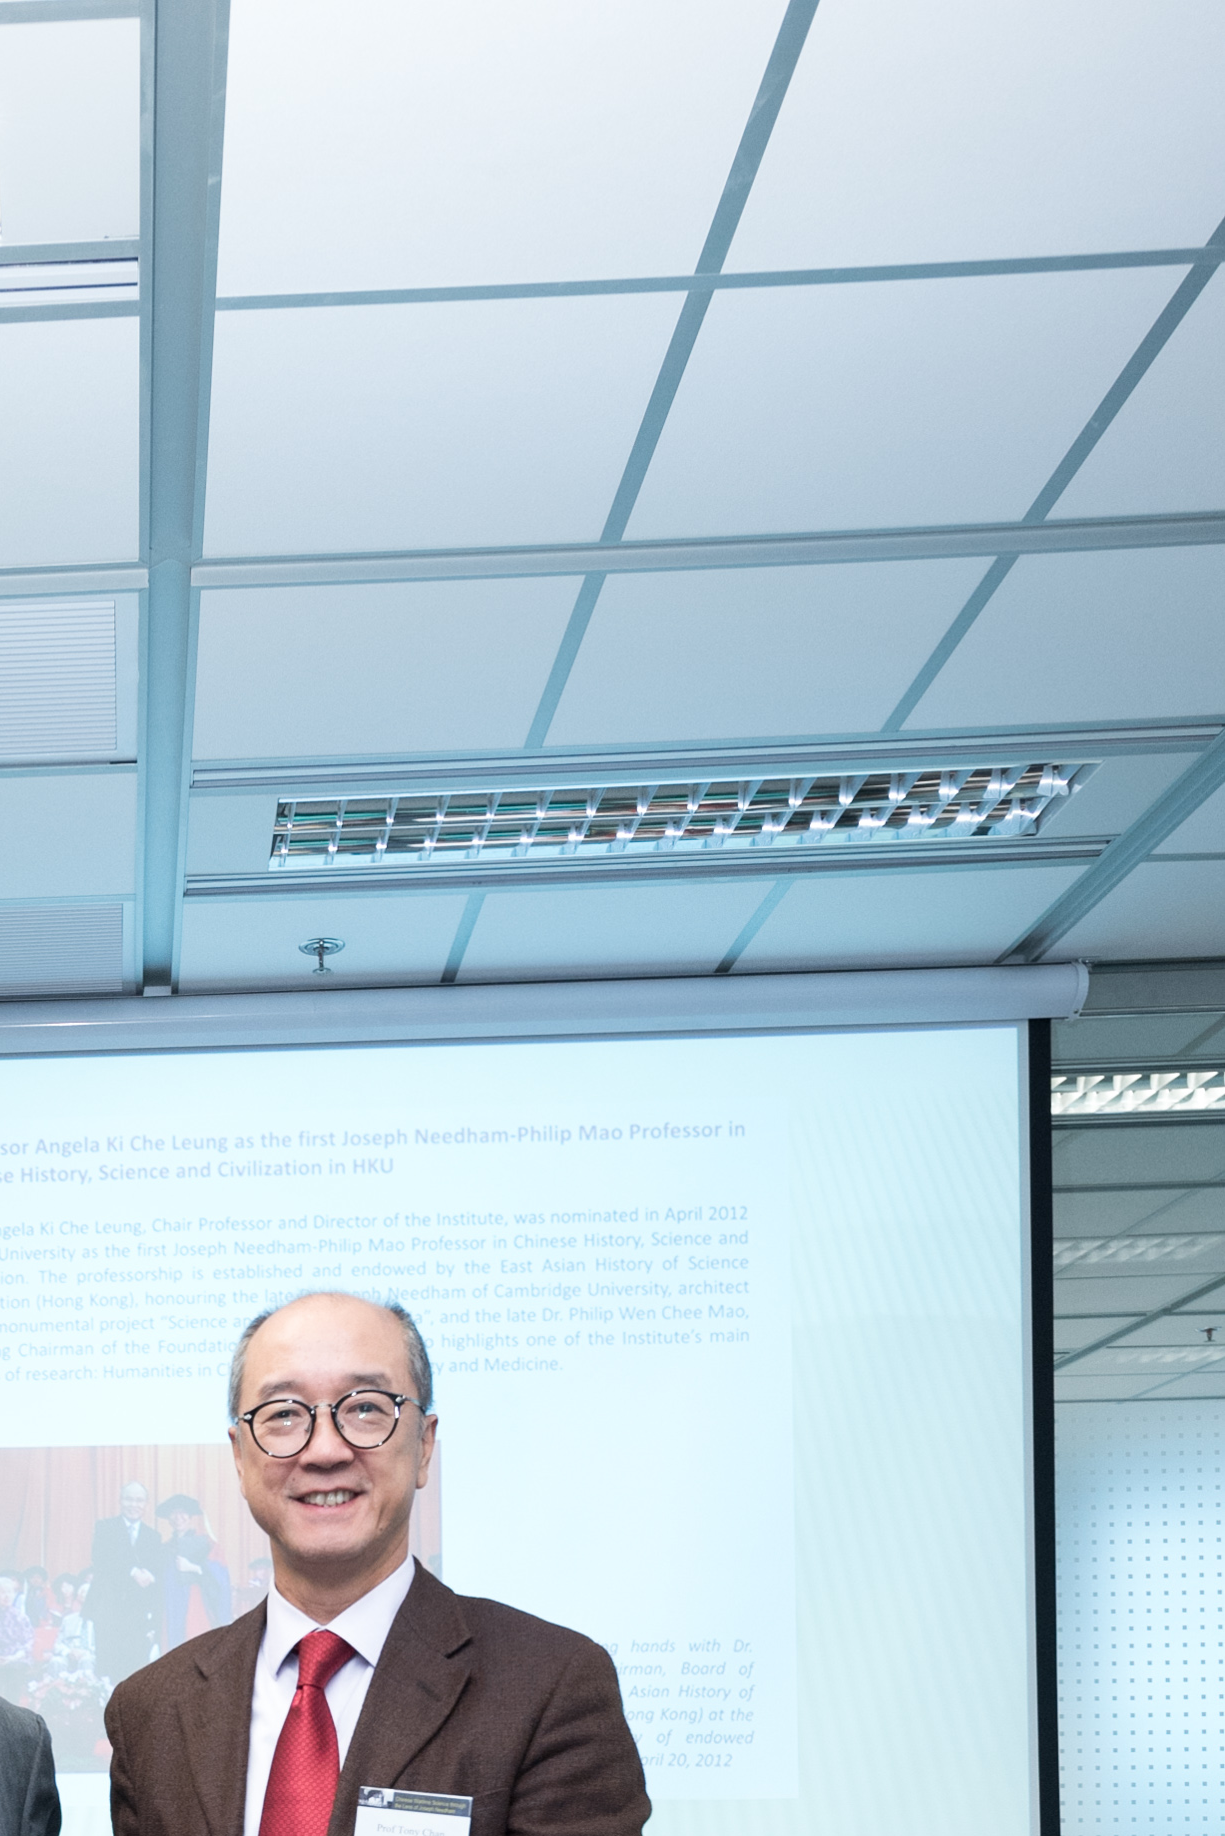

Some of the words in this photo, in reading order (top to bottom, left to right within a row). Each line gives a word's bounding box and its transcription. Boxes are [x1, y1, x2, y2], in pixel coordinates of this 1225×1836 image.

[34, 1136, 101, 1158] Angela
[106, 1135, 124, 1153] Ki
[129, 1134, 166, 1152] Che
[171, 1134, 229, 1154] Leung
[233, 1135, 255, 1150] as
[259, 1130, 293, 1149] the
[297, 1130, 337, 1148] first
[341, 1128, 409, 1149] Joseph
[414, 1125, 573, 1145] Needham-Philip
[578, 1124, 624, 1141] Mao
[628, 1121, 723, 1140] Professor
[727, 1119, 746, 1138] in
[20, 1166, 93, 1184] History,
[98, 1163, 170, 1181] Science
[175, 1161, 212, 1179] and
[216, 1159, 323, 1178] Civilization
[328, 1158, 347, 1175] in
[352, 1156, 395, 1175] HKU
[39, 1220, 55, 1236] Ki
[58, 1220, 90, 1236] Che
[94, 1220, 147, 1237] Leung,
[151, 1217, 193, 1233] Chair
[198, 1216, 273, 1232] Professor
[277, 1214, 308, 1231] and
[312, 1213, 379, 1230] Director
[382, 1212, 401, 1228] of
[403, 1211, 432, 1228] the
[436, 1211, 509, 1227] Institute,
[512, 1211, 547, 1225] was
[549, 1206, 640, 1224] nominated
[644, 1206, 660, 1222] in
[663, 1205, 704, 1225] April
[707, 1204, 749, 1222] 2012
[81, 1246, 99, 1259] as
[104, 1243, 132, 1259] the
[136, 1241, 167, 1258] first
[172, 1241, 228, 1257] Joseph
[233, 1238, 363, 1255] Needham-Philip
[367, 1236, 406, 1253] Mao
[410, 1235, 487, 1252] Professor
[492, 1234, 508, 1249] in
[512, 1233, 578, 1250] Chinese
[583, 1232, 645, 1249] History,
[650, 1230, 713, 1247] Science
[717, 1229, 750, 1245] and
[37, 1268, 68, 1284] The
[76, 1266, 184, 1285] professorship
[191, 1265, 205, 1281] is
[212, 1263, 304, 1280] established
[311, 1262, 343, 1278] and
[350, 1261, 427, 1277] endowed
[435, 1259, 456, 1279] by
[463, 1259, 492, 1275] the
[499, 1258, 533, 1274] East
[541, 1257, 587, 1273] Asian
[594, 1256, 654, 1274] History
[661, 1253, 680, 1272] of
[687, 1254, 750, 1271] Science
[35, 1294, 85, 1312] (Hong
[88, 1292, 139, 1310] Kong),
[144, 1291, 227, 1308] honouring
[231, 1288, 260, 1304] the
[387, 1284, 467, 1302] Needham
[471, 1282, 490, 1300] of
[493, 1282, 582, 1301] Cambridge
[587, 1281, 673, 1298] University,
[677, 1279, 750, 1295] architect
[98, 1316, 156, 1334] project
[159, 1314, 228, 1330] “Science
[232, 1317, 252, 1329] an
[439, 1308, 471, 1325] and
[474, 1307, 503, 1324] the
[506, 1307, 537, 1323] late
[541, 1306, 564, 1323] Dr.
[568, 1305, 615, 1323] Philip
[617, 1305, 657, 1321] Wen
[660, 1304, 704, 1321] Chee
[707, 1304, 750, 1320] Mao,
[17, 1342, 95, 1358] Chairman
[100, 1339, 118, 1356] of
[123, 1339, 151, 1355] the
[157, 1338, 237, 1354] Foundatio
[440, 1332, 520, 1352] highlights
[525, 1334, 558, 1348] one
[563, 1329, 582, 1347] of
[586, 1330, 616, 1346] the
[621, 1328, 703, 1345] Institute’s
[709, 1327, 751, 1343] main
[4, 1365, 23, 1382] of
[25, 1365, 98, 1381] research:
[102, 1364, 194, 1379] Humanities
[197, 1363, 213, 1377] in
[447, 1356, 480, 1373] and
[483, 1356, 564, 1372] Medicine.
[629, 1639, 677, 1653] hands
[687, 1637, 722, 1653] with
[732, 1637, 753, 1653] Dr.
[617, 1662, 667, 1678] irman,
[680, 1660, 727, 1676] Board
[737, 1660, 756, 1679] of
[627, 1684, 671, 1699] Asian
[677, 1684, 733, 1702] History
[737, 1683, 757, 1702] of
[626, 1709, 655, 1724] ong
[659, 1706, 704, 1725] Kong)
[707, 1708, 725, 1722] at
[729, 1706, 755, 1722] the
[655, 1727, 674, 1747] of
[684, 1728, 756, 1745] endowed
[641, 1754, 664, 1768] pril
[667, 1751, 691, 1769] 20,
[694, 1752, 734, 1768] 2012
[377, 1824, 396, 1833] Prof
[396, 1826, 420, 1836] Tony
